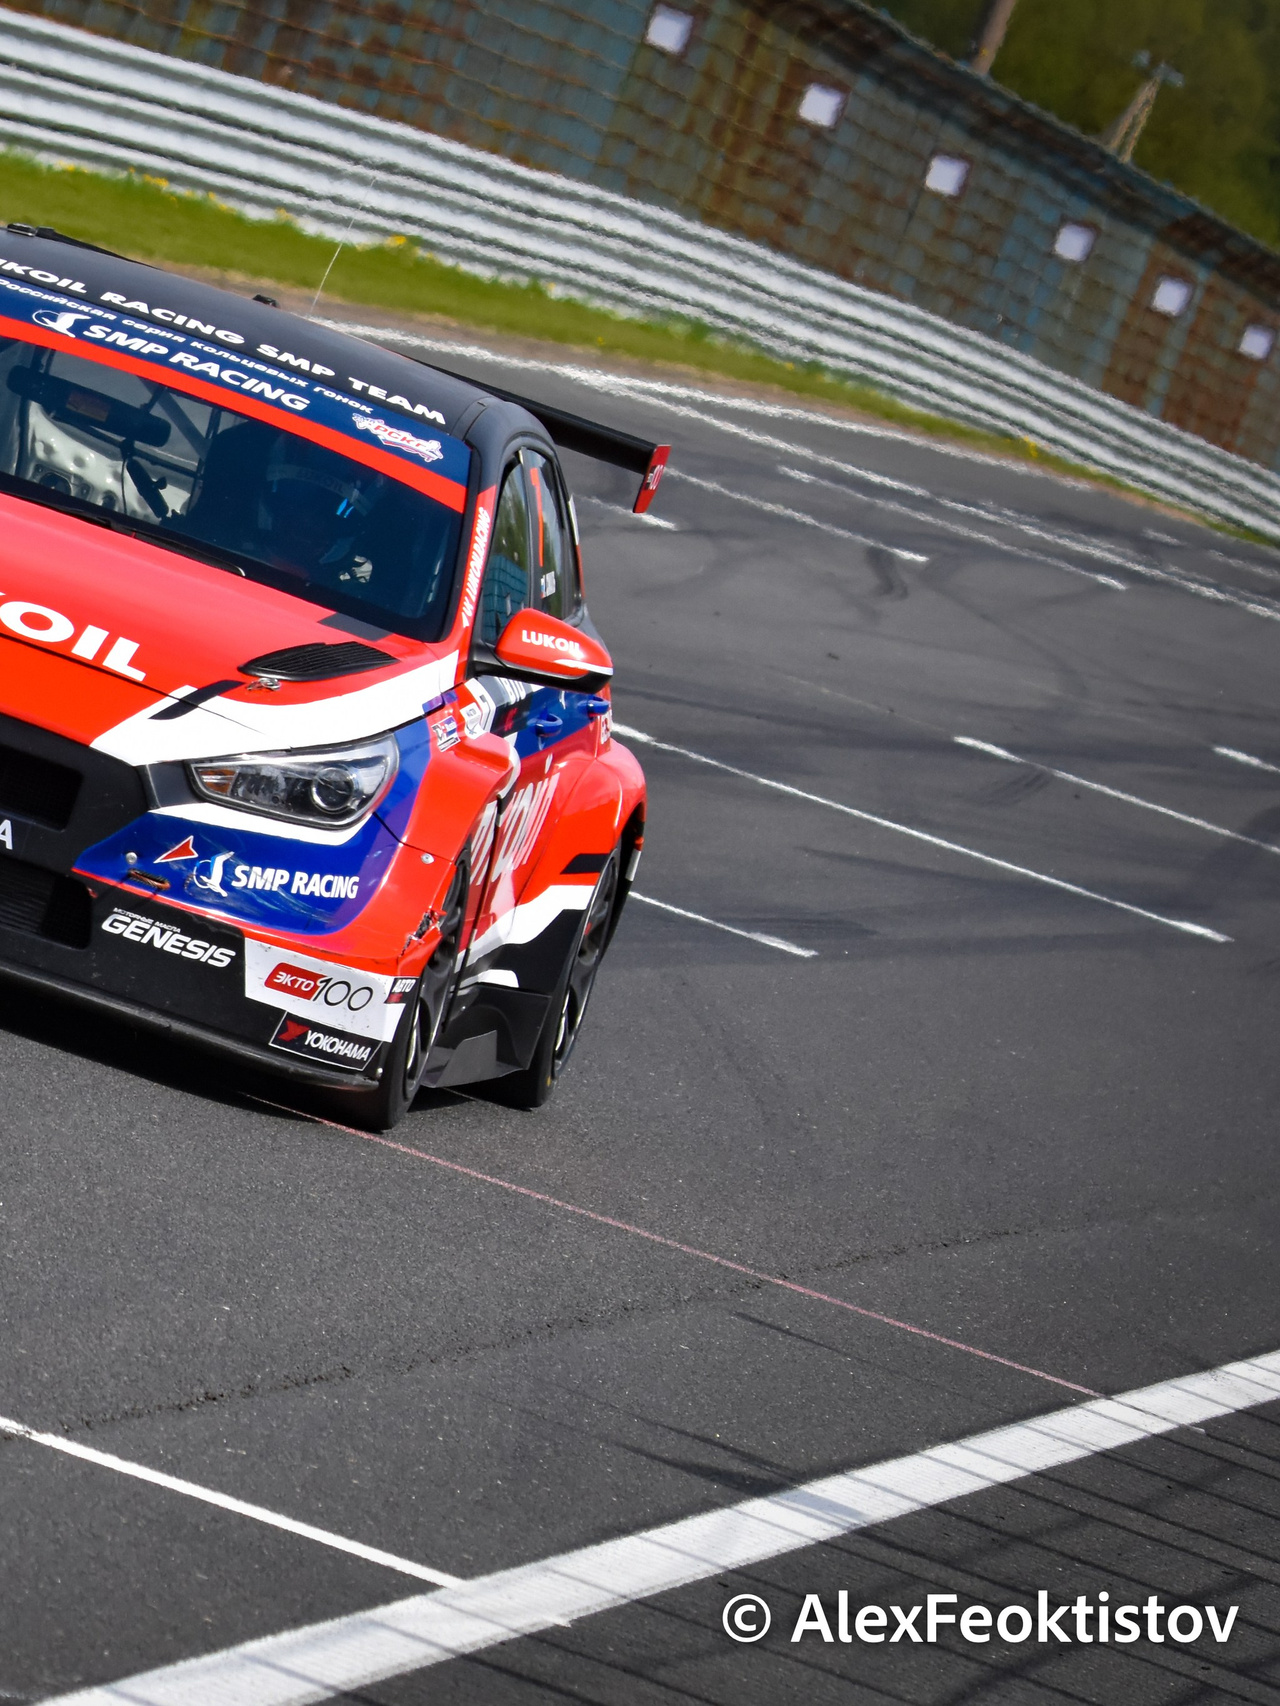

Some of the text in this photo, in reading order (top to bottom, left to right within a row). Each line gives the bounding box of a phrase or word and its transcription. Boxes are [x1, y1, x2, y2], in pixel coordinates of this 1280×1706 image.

[83, 324, 310, 411] SMP RACING
[100, 292, 245, 345] RACING
[256, 344, 335, 377] SMP
[348, 377, 445, 425] TEAM
[121, 319, 186, 343] серия
[313, 387, 374, 414] гонок
[522, 630, 581, 653] LUKOIL
[231, 866, 360, 899] SMP RACING
[101, 913, 236, 968] GENESIS
[273, 971, 374, 1011] ЭКТО 100
[304, 1030, 372, 1062] YOKOHAMA
